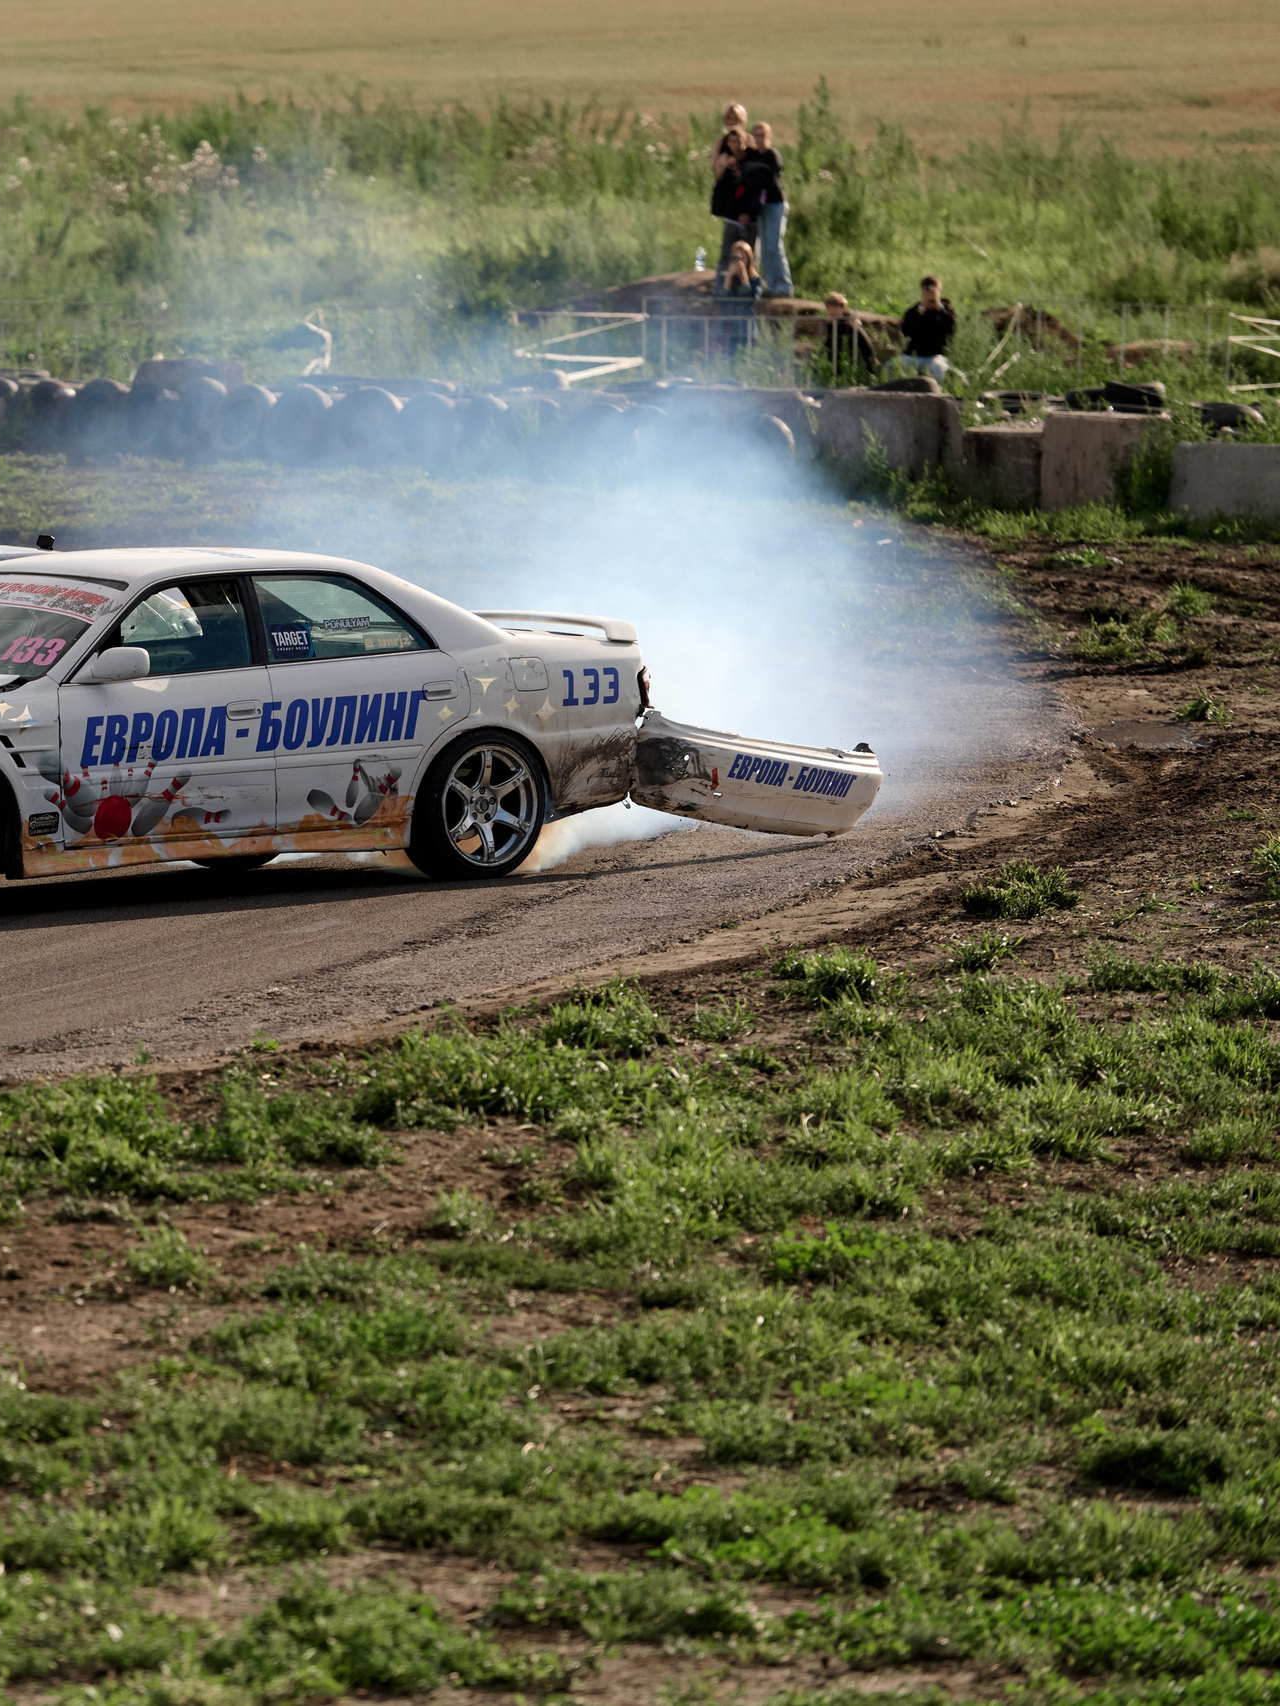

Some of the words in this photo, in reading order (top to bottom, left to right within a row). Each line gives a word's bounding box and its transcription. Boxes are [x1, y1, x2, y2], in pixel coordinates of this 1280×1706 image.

[0, 636, 67, 666] 133
[271, 630, 309, 647] TARGET
[562, 667, 619, 707] 133
[79, 705, 228, 768] ЕВРОПА
[255, 689, 429, 753] БОУЛИНГ
[726, 753, 790, 788] ЕВРОПА
[792, 765, 858, 799] БОУЛИНГ
